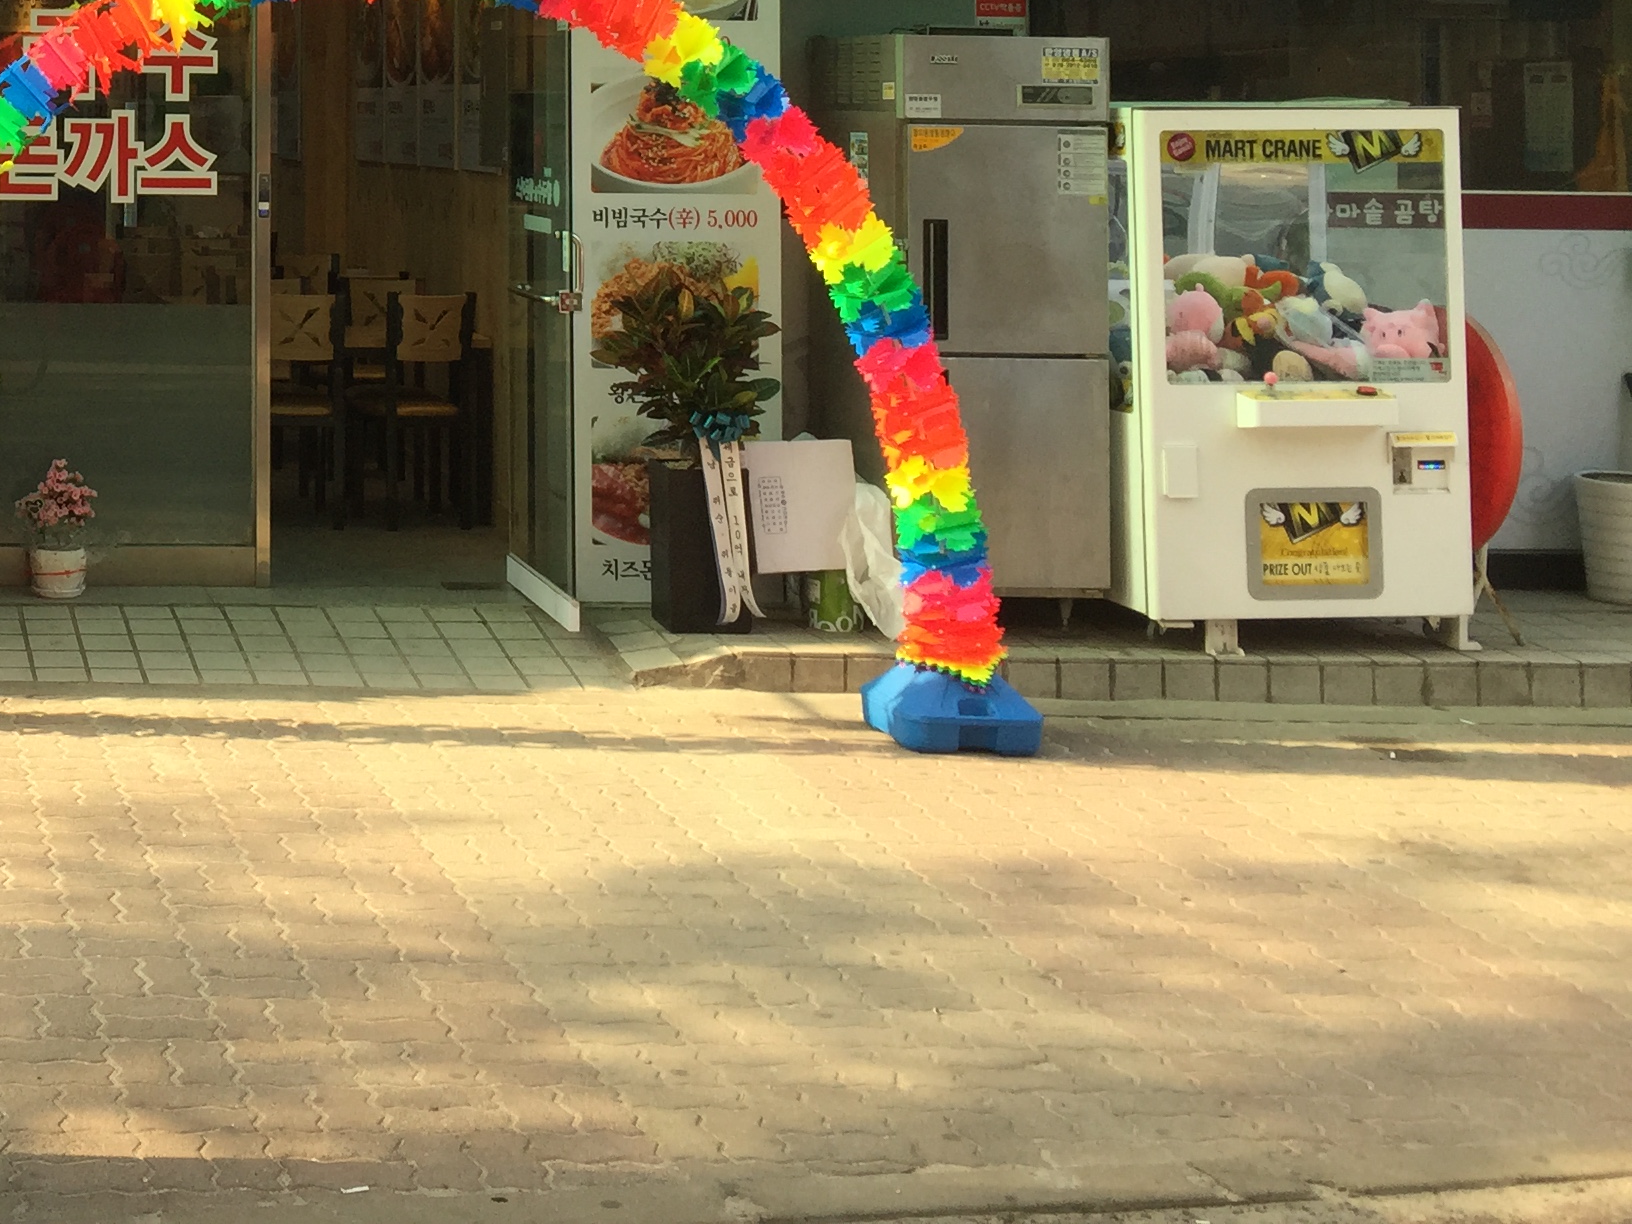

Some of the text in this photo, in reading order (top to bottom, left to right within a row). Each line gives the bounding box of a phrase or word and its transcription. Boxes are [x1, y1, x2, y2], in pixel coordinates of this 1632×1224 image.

[1206, 139, 1256, 160] MART
[1261, 139, 1323, 160] CRANE
[707, 208, 759, 230] 5,000
[1394, 199, 1443, 224] 곰탕
[1262, 563, 1289, 576] PRIZE
[1291, 563, 1313, 576] OUT
